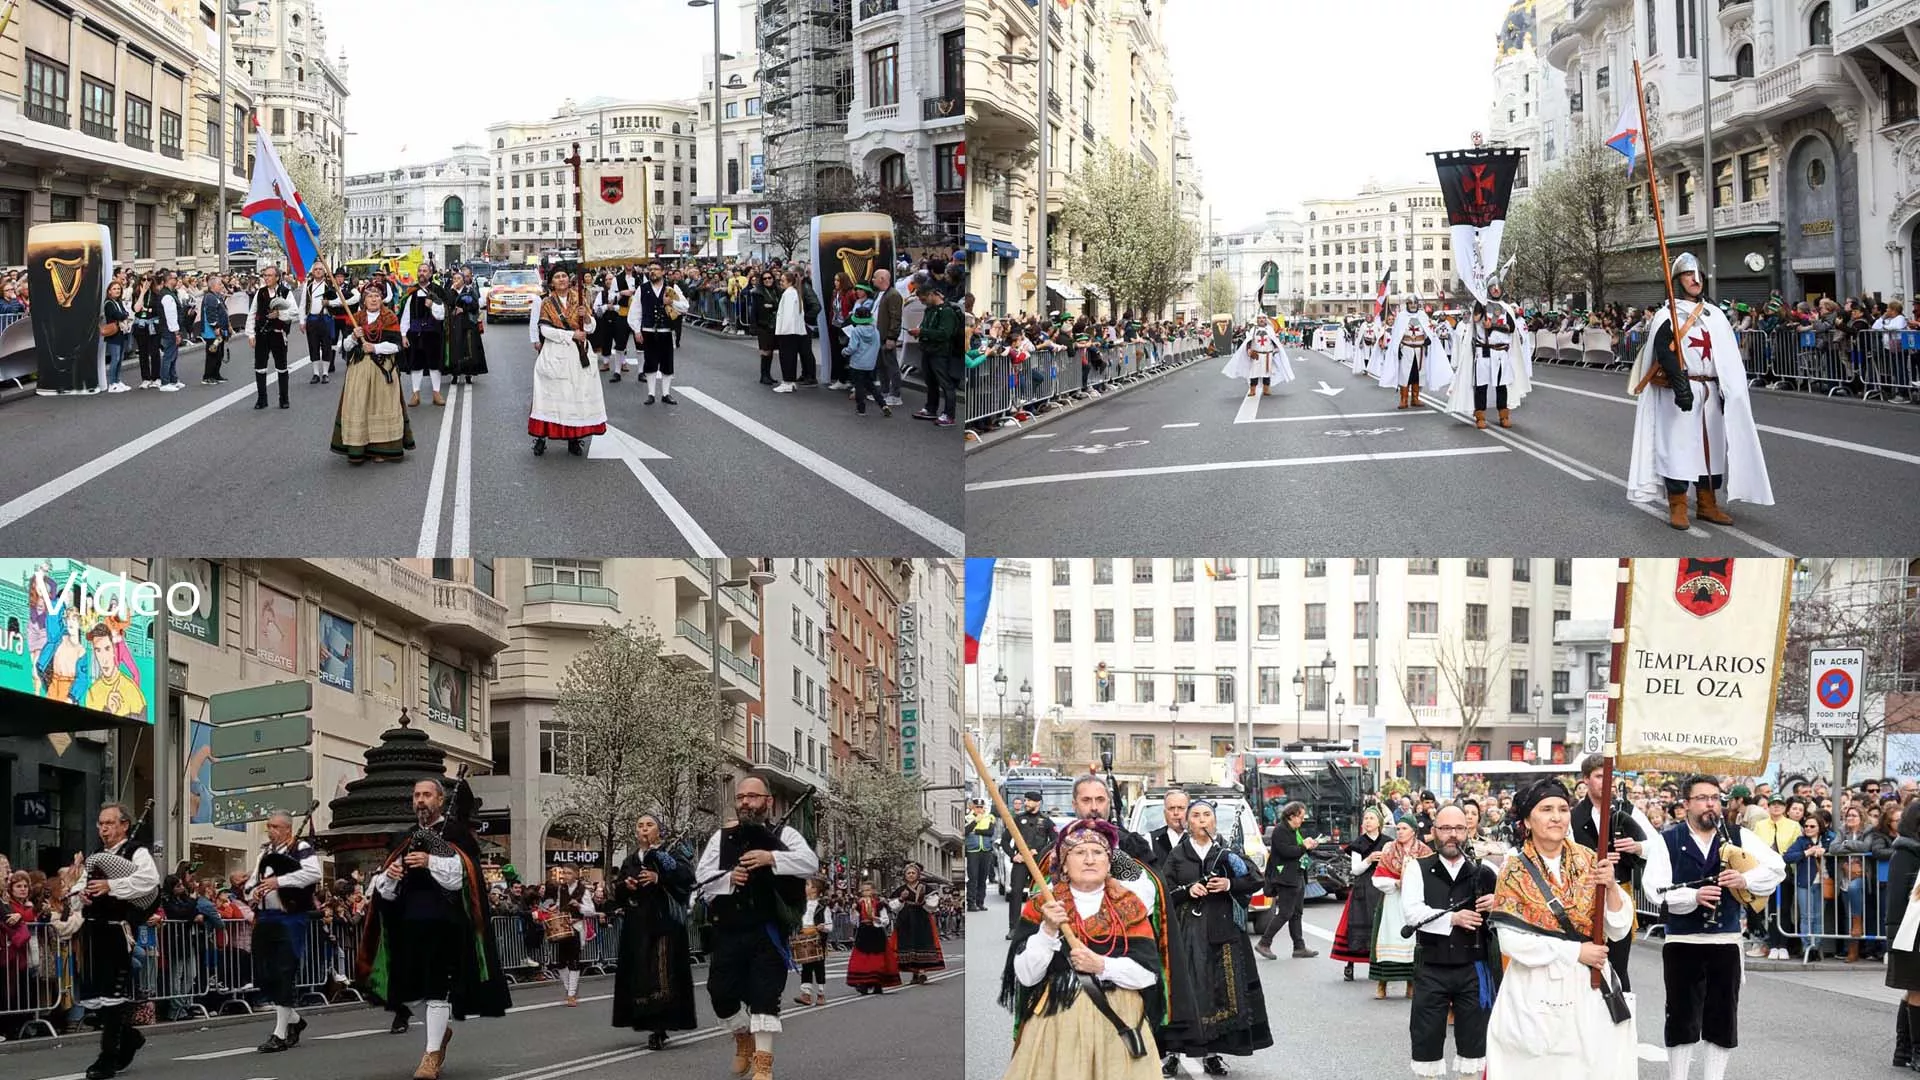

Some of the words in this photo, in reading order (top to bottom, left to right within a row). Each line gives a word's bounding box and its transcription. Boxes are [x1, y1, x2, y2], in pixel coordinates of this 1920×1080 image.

[586, 216, 642, 227] TEMPLARIOS
[593, 228, 610, 237] DEL
[614, 226, 635, 235] OZA
[168, 615, 206, 638] REATE
[900, 605, 918, 703] SENATOR
[1635, 649, 1767, 674] TEMPLARIOS
[1645, 677, 1685, 695] DEL
[1696, 677, 1743, 698] OZA
[428, 707, 464, 729] CREATE
[901, 709, 918, 779] HOTE
[1642, 731, 1674, 742] TORAL
[1676, 732, 1692, 743] DE
[1693, 734, 1738, 747] MERAYO
[553, 851, 599, 863] ALE-HOP
